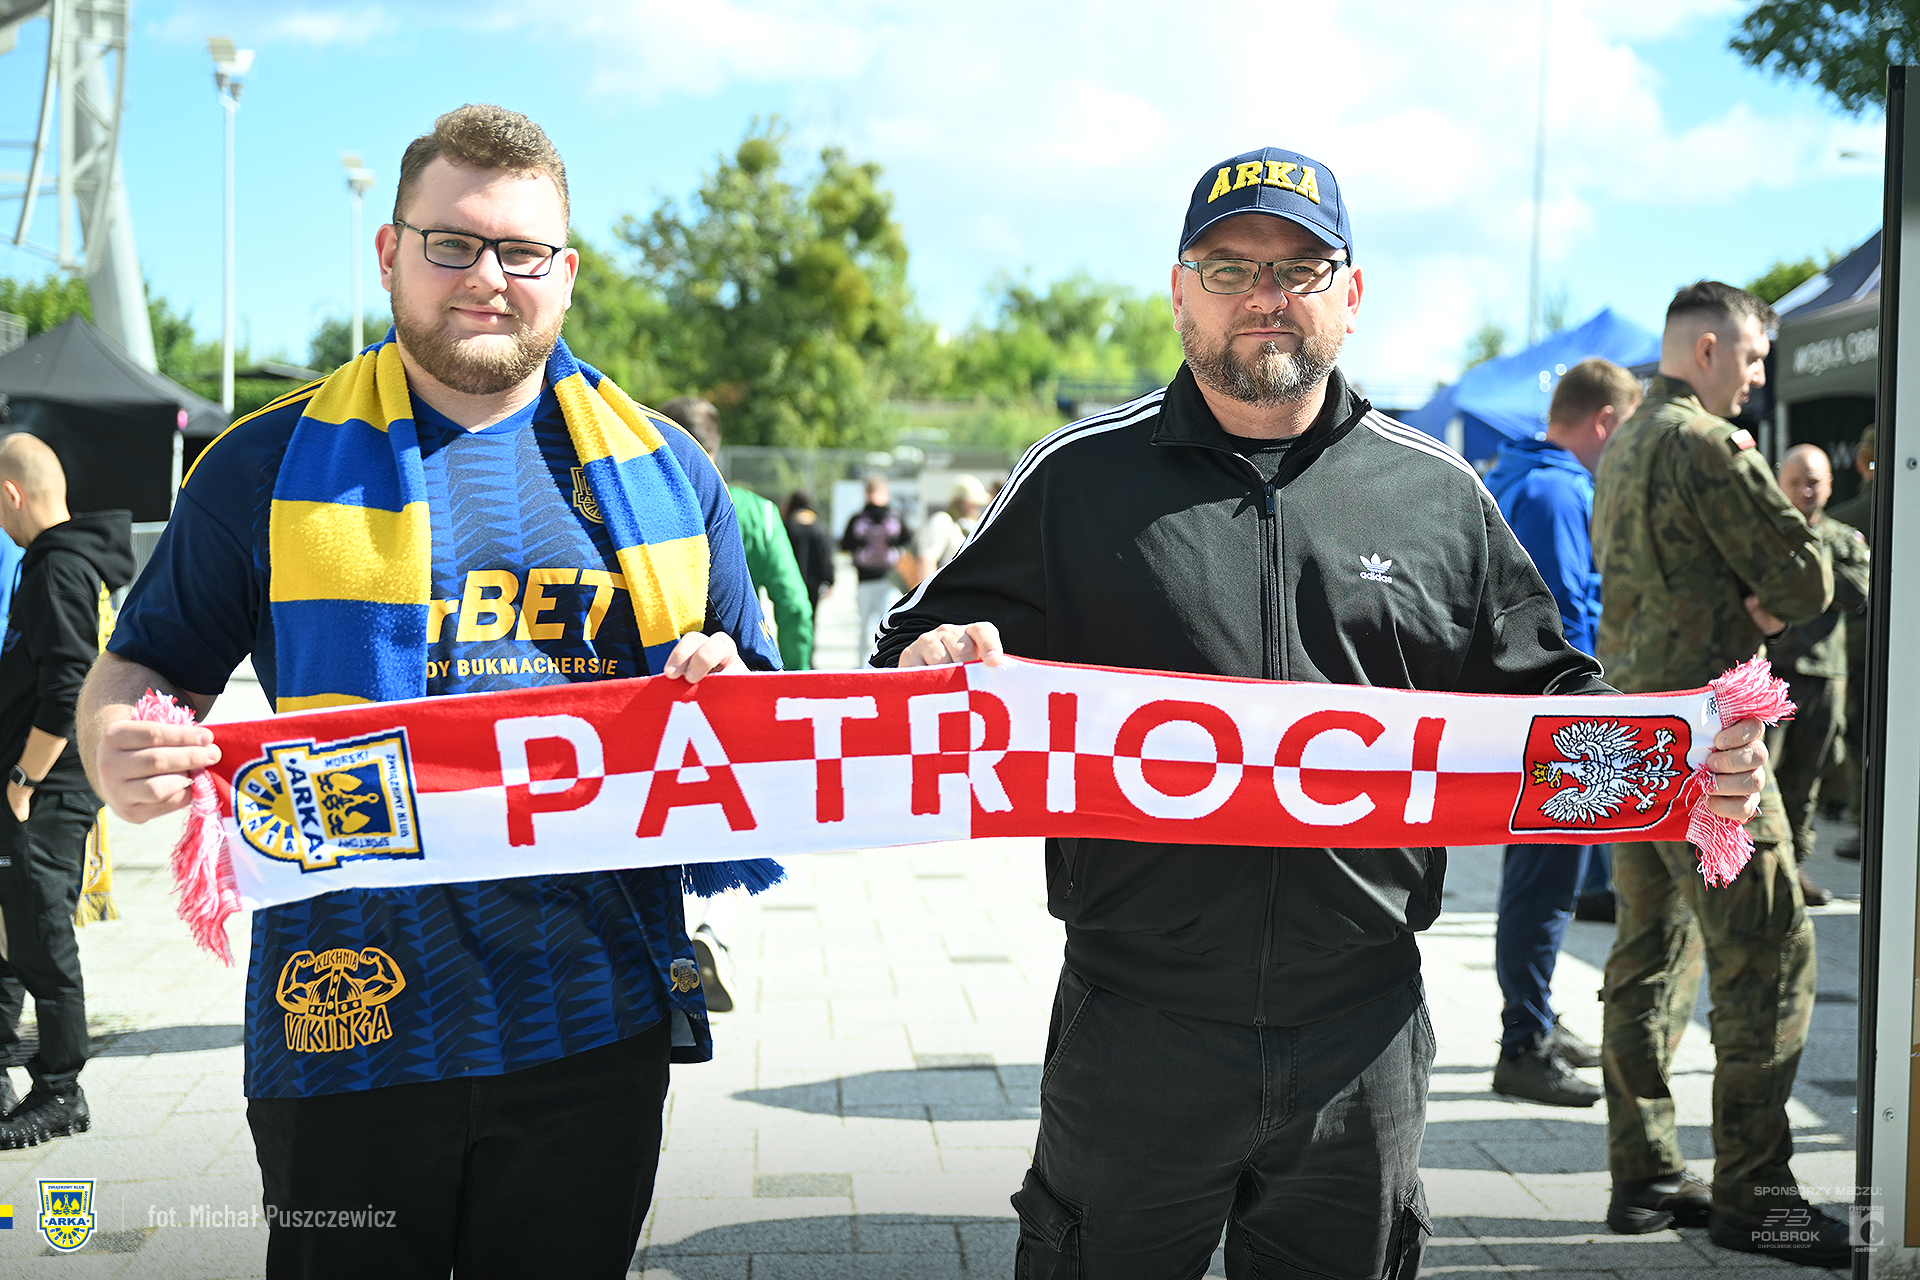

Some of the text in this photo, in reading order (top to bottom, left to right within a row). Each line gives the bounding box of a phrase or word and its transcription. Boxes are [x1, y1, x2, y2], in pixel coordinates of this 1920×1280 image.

[1207, 160, 1321, 204] ARKA
[1360, 570, 1393, 583] adidas
[426, 568, 628, 643] rBET
[427, 656, 618, 679] DY BUKMACHERSIE
[324, 750, 369, 768] MORSKI
[495, 690, 1447, 847] PATRIOCI
[398, 811, 410, 838] KLUB
[315, 950, 358, 972] KUCHNIA
[285, 1004, 393, 1053] VIKINGA
